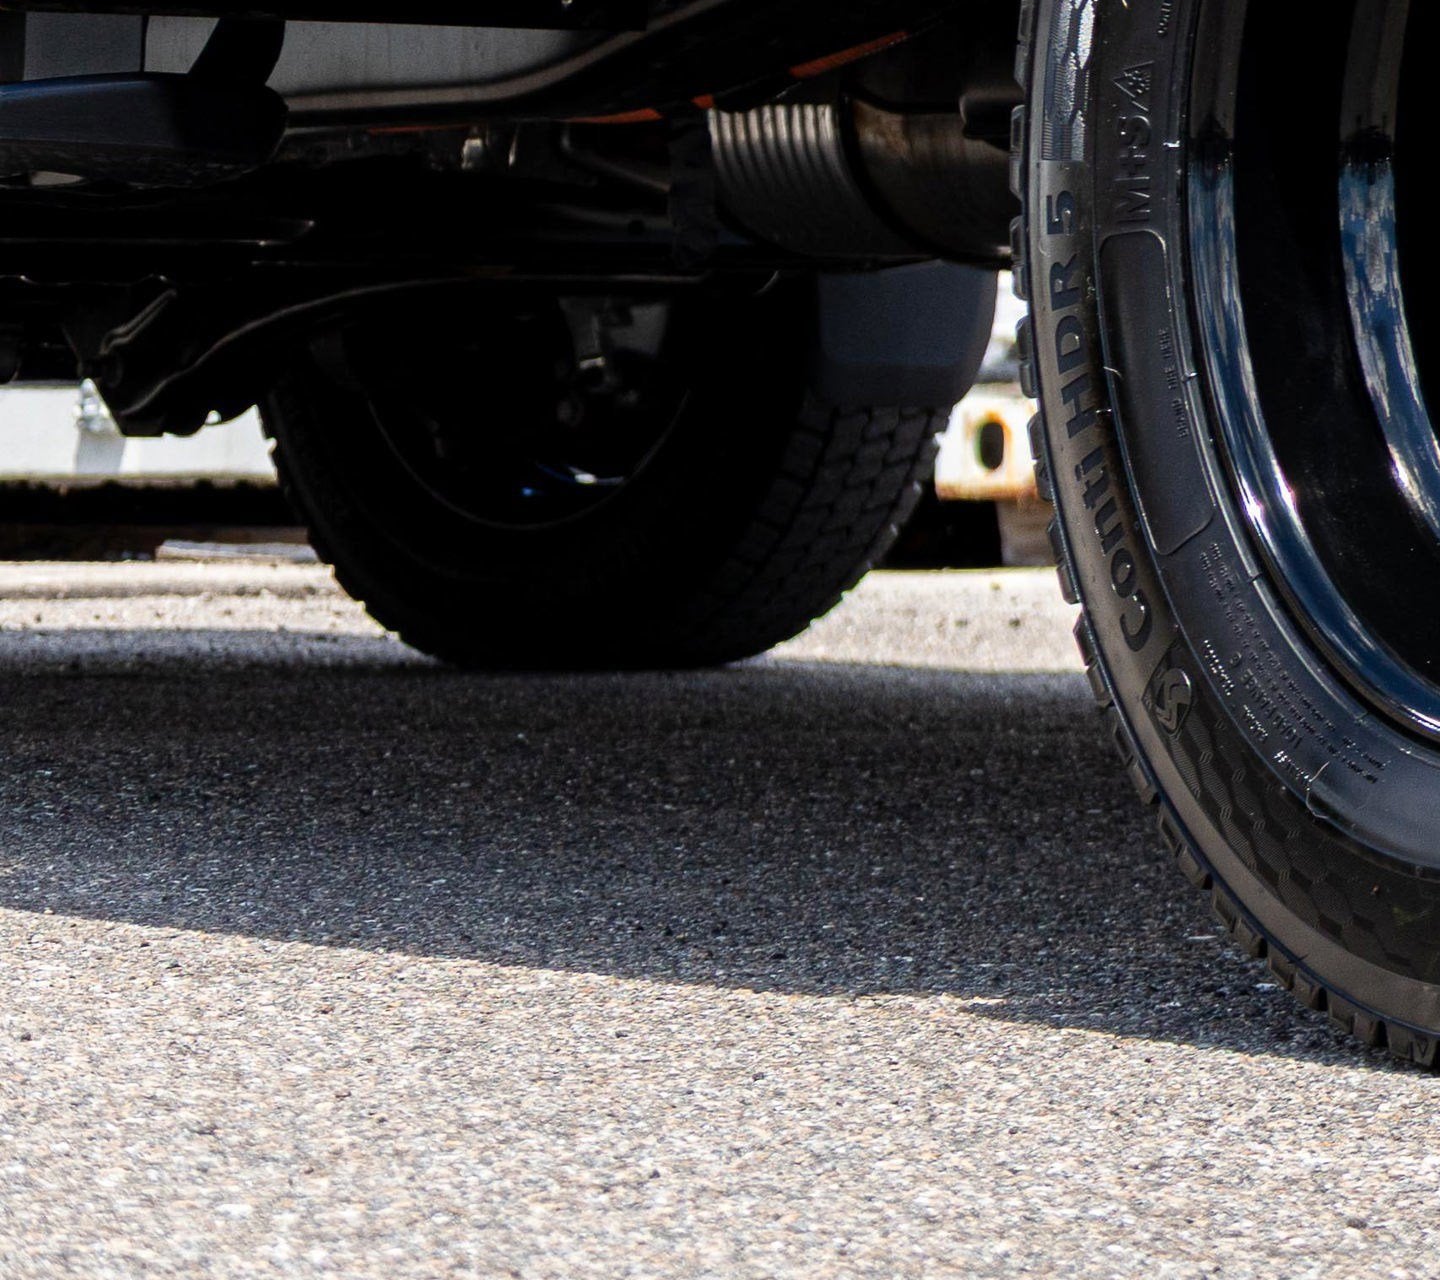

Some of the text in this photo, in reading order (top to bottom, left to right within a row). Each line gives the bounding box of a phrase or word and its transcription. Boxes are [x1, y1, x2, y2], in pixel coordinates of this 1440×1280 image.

[1045, 189, 1154, 654] Conti HDR 5
